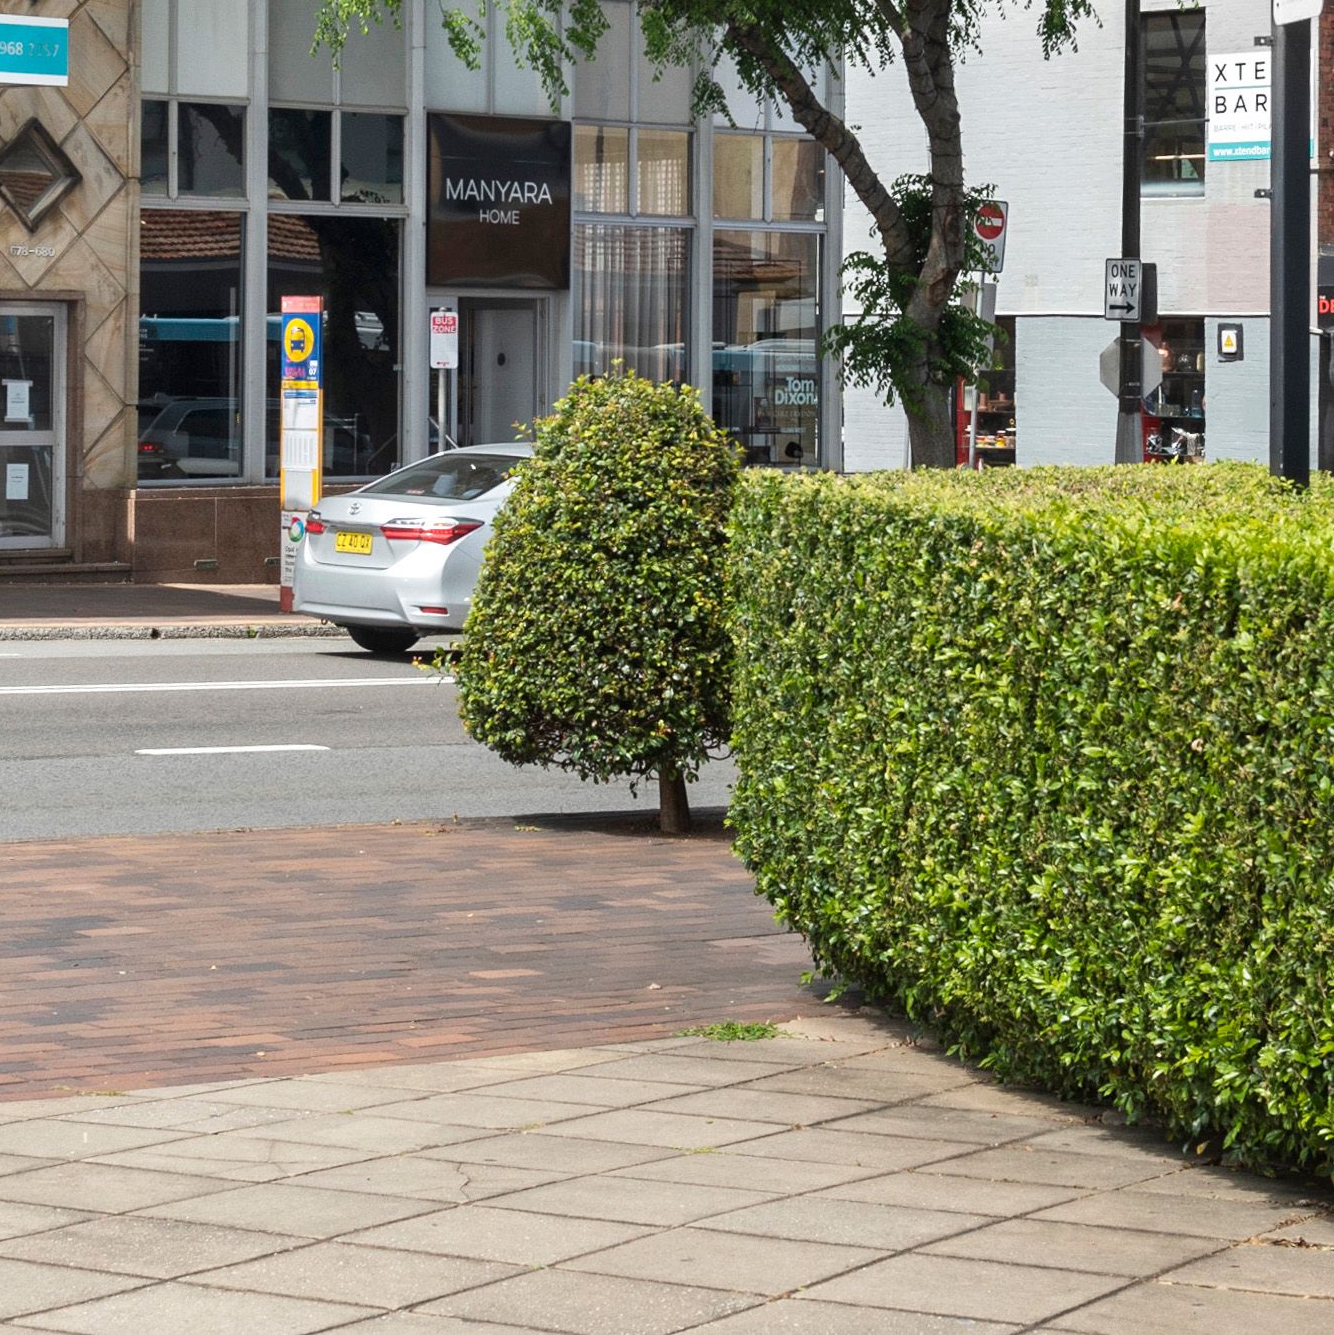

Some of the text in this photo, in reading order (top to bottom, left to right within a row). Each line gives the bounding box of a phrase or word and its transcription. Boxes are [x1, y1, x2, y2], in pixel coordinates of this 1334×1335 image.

[1215, 61, 1266, 82] XTE
[1215, 94, 1267, 114] BAR
[1213, 145, 1271, 157] www.xtendbar
[446, 178, 552, 205] MANYARA
[479, 209, 520, 225] HOME
[1111, 264, 1135, 278] ONE
[1109, 283, 1137, 297] WAY
[436, 316, 454, 325] BUS
[432, 324, 457, 334] ZONE
[786, 376, 814, 392] Tom
